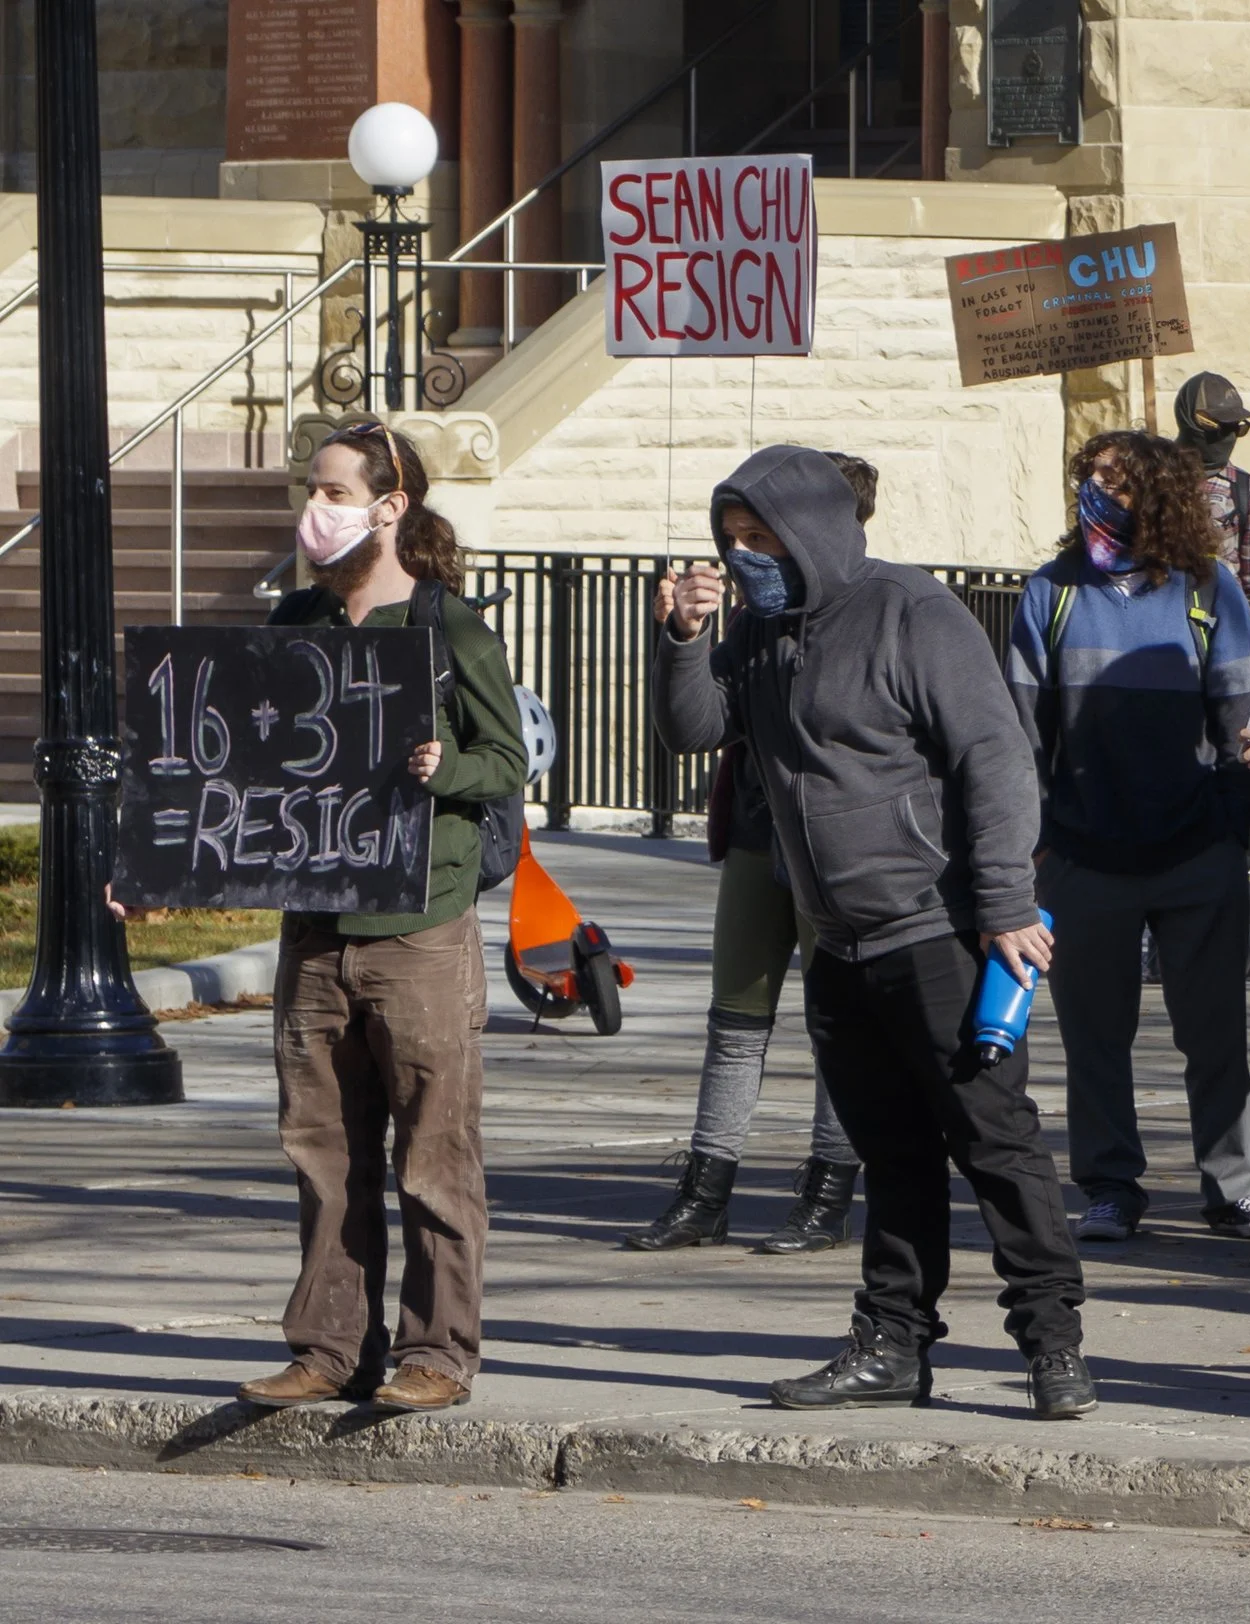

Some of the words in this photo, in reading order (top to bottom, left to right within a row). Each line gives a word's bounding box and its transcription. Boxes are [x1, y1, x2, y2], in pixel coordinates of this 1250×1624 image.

[609, 166, 725, 247] SEAN
[733, 165, 809, 244] CHU
[955, 243, 1064, 282] RESIGN
[1069, 240, 1156, 288] CHU
[613, 248, 802, 346] RESIGN
[961, 296, 976, 309] IN
[980, 287, 1008, 304] CASE
[1015, 282, 1036, 294] YOU
[975, 300, 1023, 319] FORGOT
[1042, 292, 1112, 310] CRIMINAL
[1120, 284, 1153, 297] CODE
[984, 345, 1006, 356] THE
[1014, 335, 1066, 350] ACCUSED
[1074, 325, 1121, 342] INDUCES
[1127, 321, 1152, 334] THE
[1050, 322, 1058, 331] IS
[1066, 314, 1120, 330] OBTAINED
[981, 358, 996, 368] TO
[1001, 351, 1044, 365] ENGAGE
[1050, 347, 1061, 358] IN
[1067, 344, 1086, 355] THE
[1092, 335, 1142, 350] ACTIVITY
[1147, 332, 1161, 344] BY
[983, 366, 1031, 380] ABUSING
[1035, 362, 1045, 373] A
[1048, 355, 1096, 371] POSITION
[1099, 352, 1111, 362] OF
[148, 652, 232, 777] 16
[281, 638, 403, 778] 34
